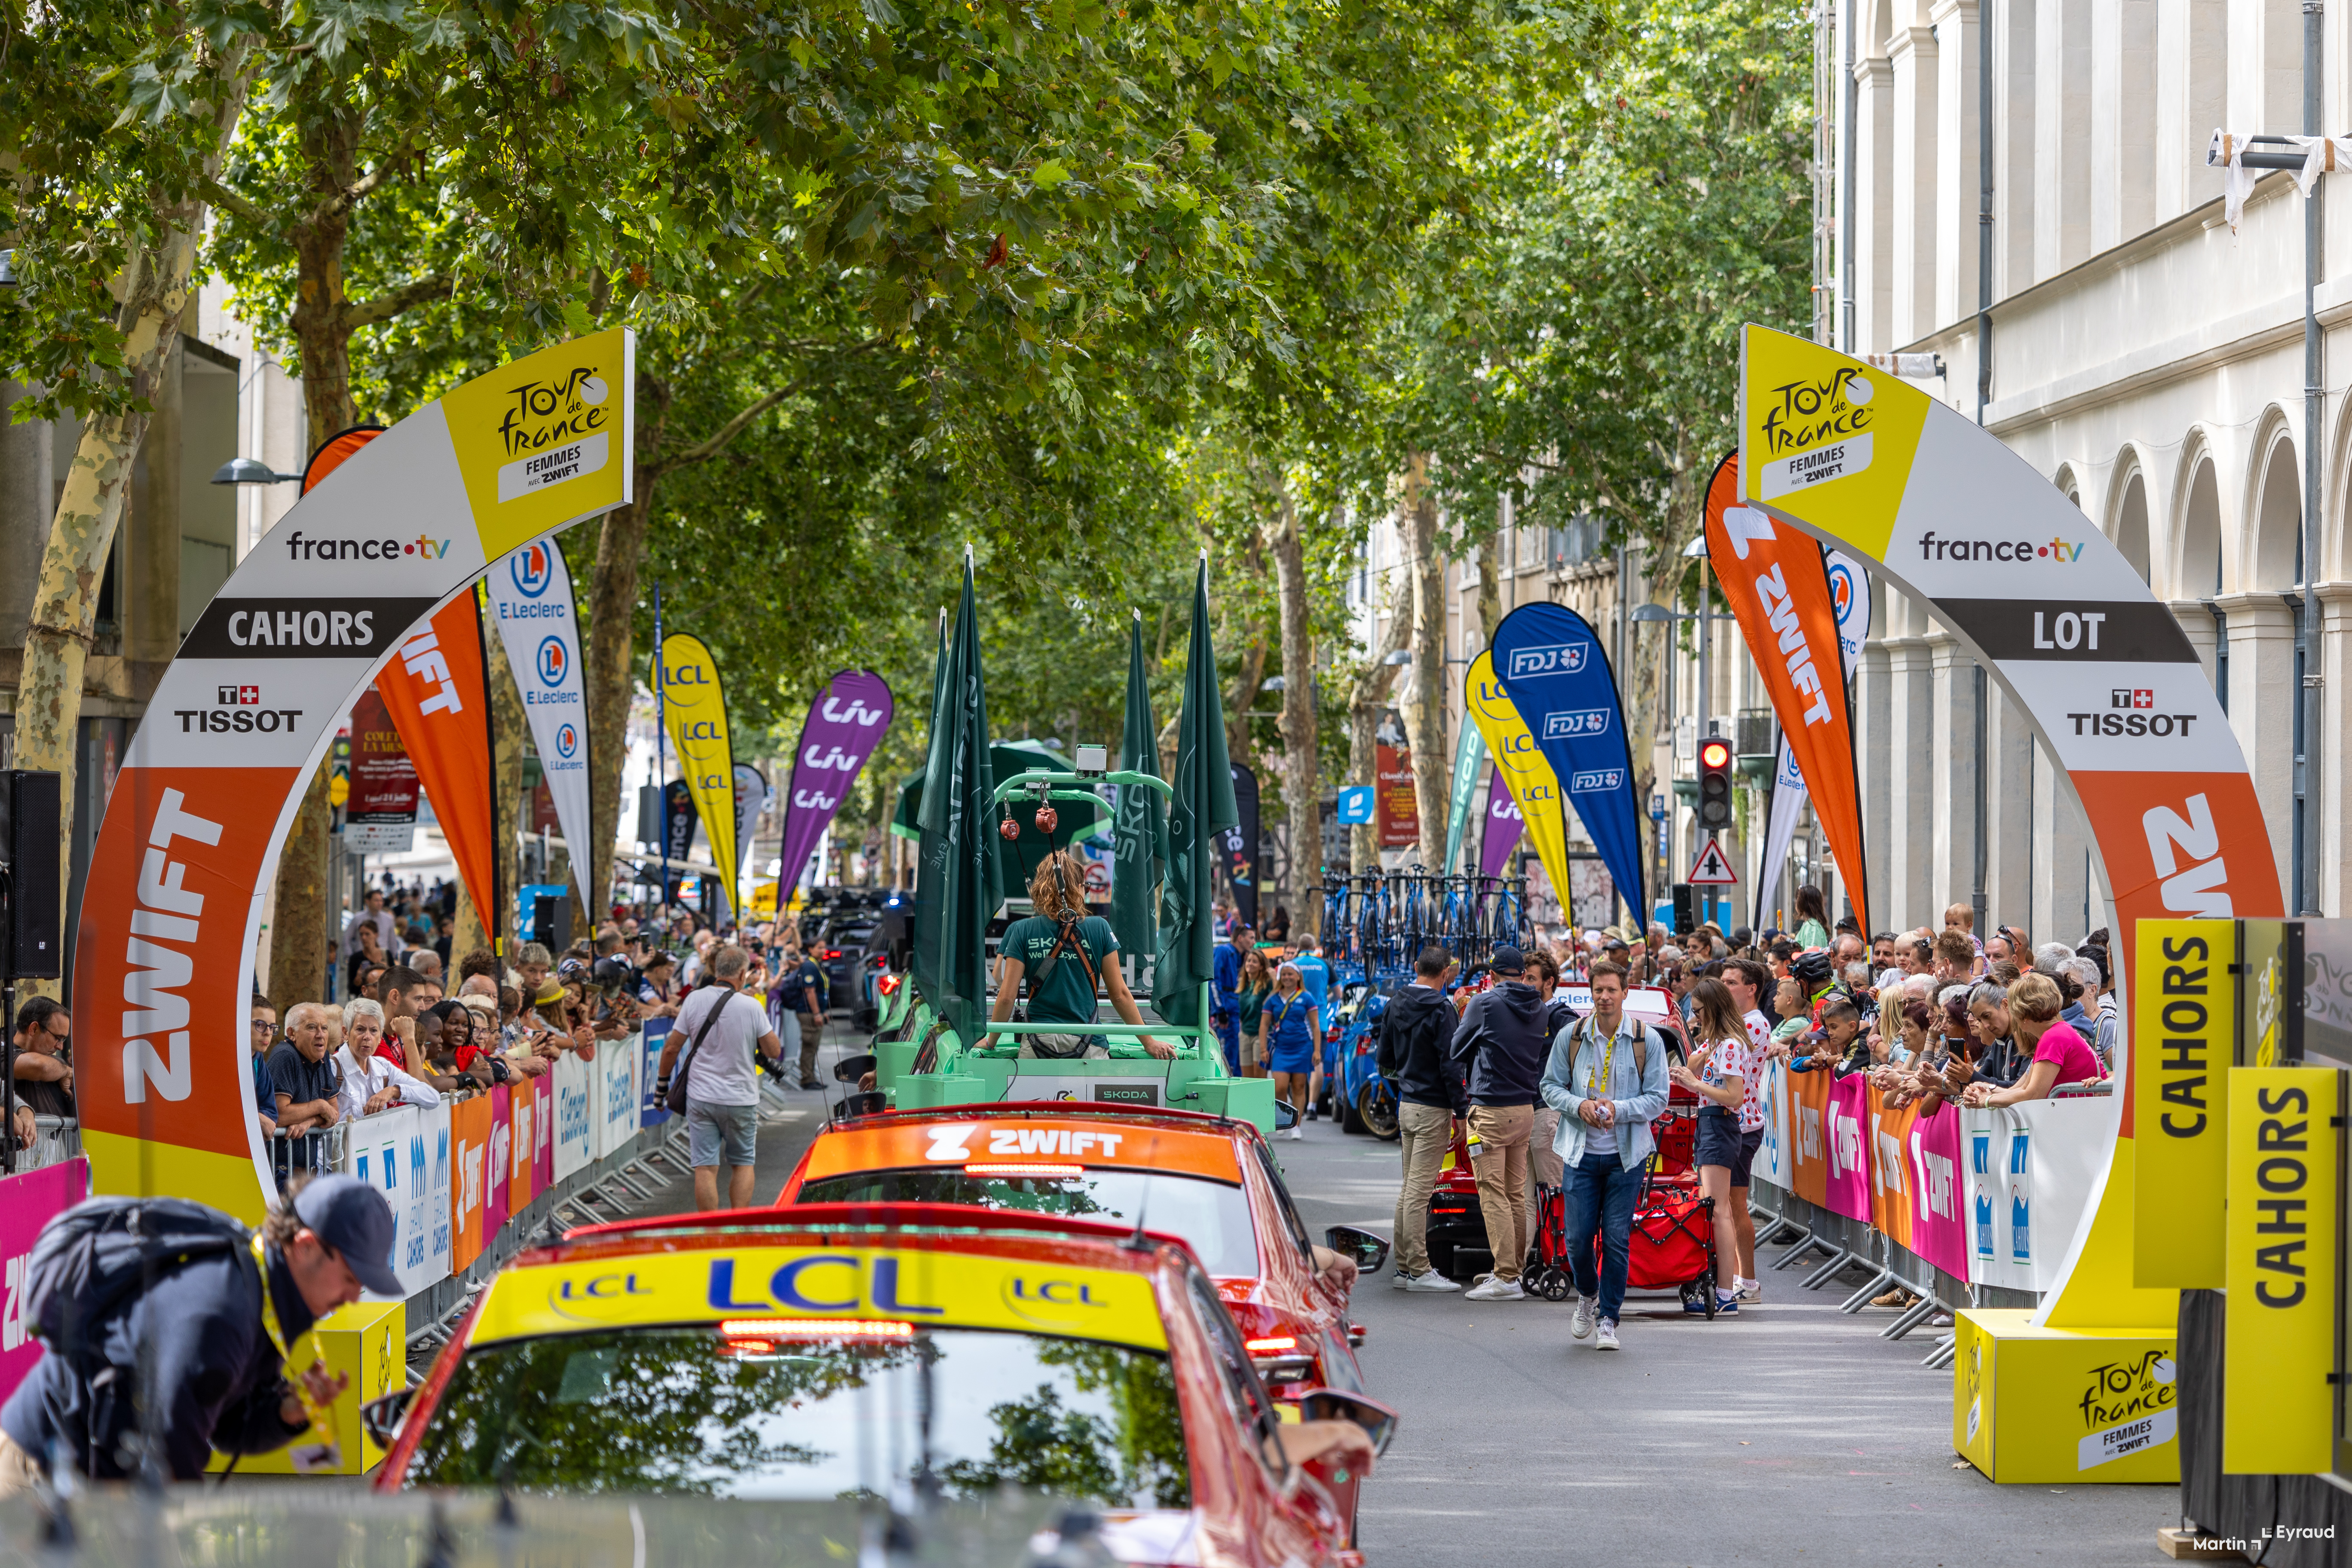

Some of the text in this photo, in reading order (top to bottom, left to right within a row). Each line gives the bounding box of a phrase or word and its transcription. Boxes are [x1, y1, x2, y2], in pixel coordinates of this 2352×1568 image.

[506, 367, 598, 422] TOUR
[567, 398, 582, 414] de
[1771, 368, 1863, 421] TOUR
[1832, 398, 1847, 413] de
[526, 445, 581, 475] FEMMES
[1789, 446, 1845, 474] FEMMES
[528, 463, 579, 487] AVEC ZWIFT
[1791, 463, 1843, 486] AVEC ZWIFT
[500, 601, 565, 619] E.Leclerc
[228, 610, 374, 646] CAHORS
[2034, 612, 2106, 650] LOT
[1755, 562, 1832, 728] ZWIFT
[1515, 650, 1557, 674] FDJ
[664, 665, 710, 686] LCL
[527, 690, 578, 705] E.Leclerc
[1480, 681, 1510, 701] LC
[174, 710, 303, 733] TISSOT
[683, 722, 722, 741] LCL
[1548, 715, 1584, 734] FDJ
[2067, 714, 2197, 737] TISSOT
[551, 761, 583, 771] E.Leclerc
[698, 775, 728, 790] LCL
[1522, 785, 1554, 801] LCL
[1575, 775, 1604, 790] FDJ
[1779, 775, 1805, 791] E.Lecler
[122, 787, 223, 1104] ZWIFT
[2161, 937, 2208, 1139] CAHORS
[989, 1130, 1122, 1157] ZWIFT
[1880, 1130, 1906, 1196] ZWIFT
[1923, 1150, 1955, 1222] ZWIFT
[2255, 1087, 2309, 1309] CAHORS
[433, 1223, 447, 1257] CAHORS
[1978, 1223, 1993, 1249] CAHORS
[2013, 1225, 2029, 1253] CAHORS
[407, 1234, 424, 1270] CAHORS
[560, 1255, 1108, 1316] LCL LCL LCL
[2087, 1349, 2168, 1399] TOUR
[2141, 1379, 2154, 1392] de
[2103, 1419, 2152, 1446] FEMMES
[2104, 1435, 2150, 1456] AVEC ZWIFT
